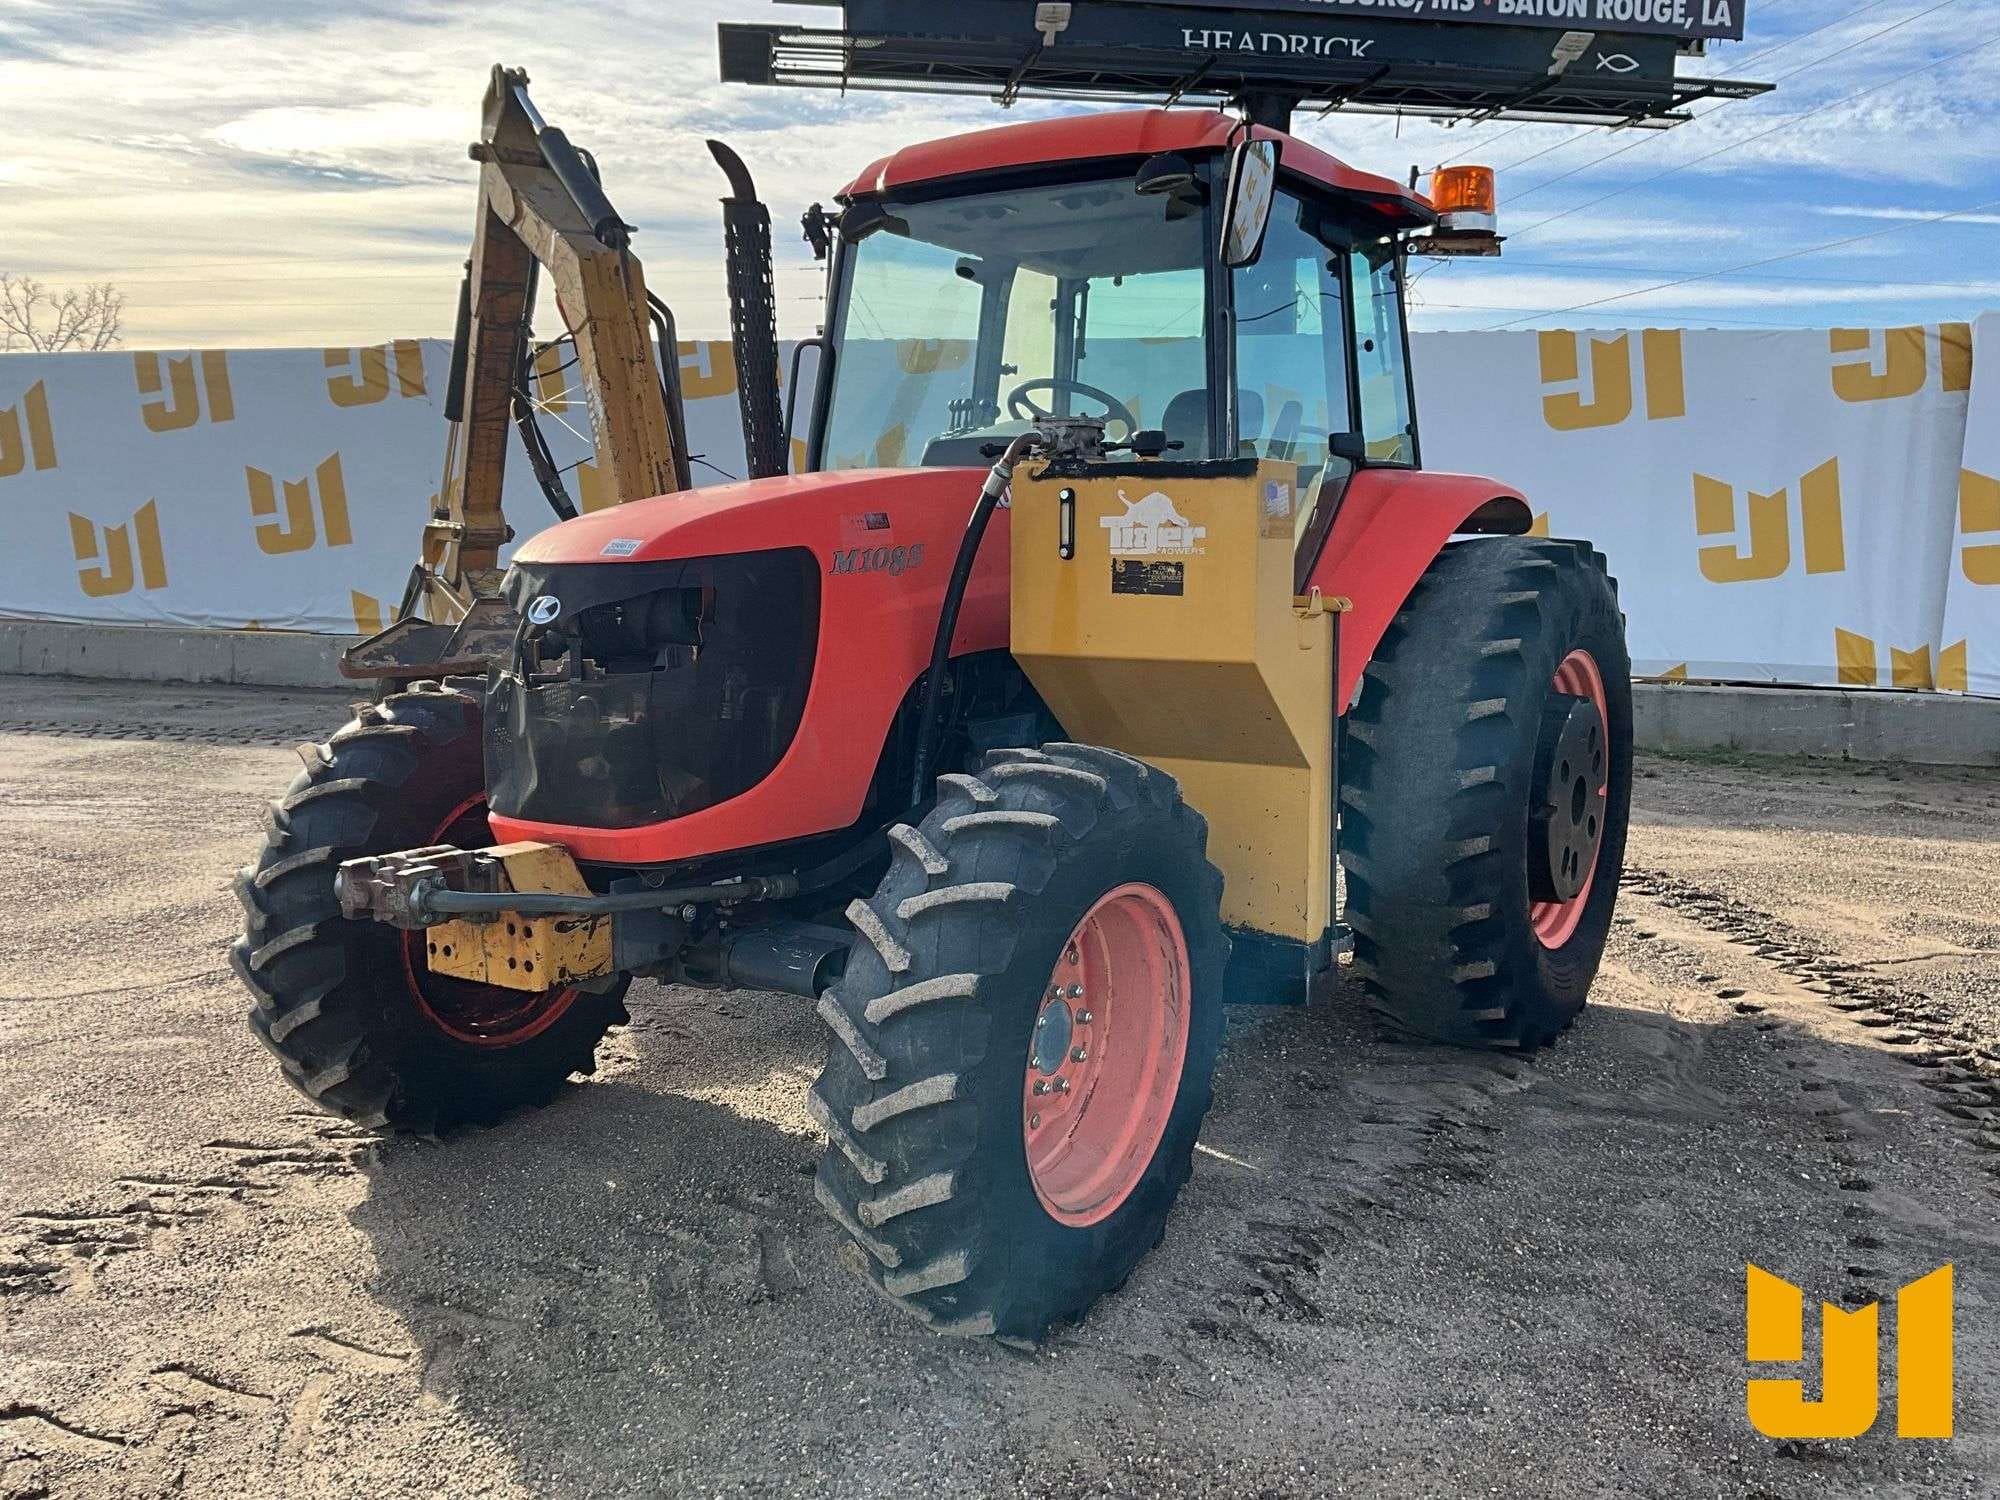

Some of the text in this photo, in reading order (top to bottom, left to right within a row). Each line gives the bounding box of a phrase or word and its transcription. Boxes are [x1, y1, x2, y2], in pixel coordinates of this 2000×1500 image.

[1597, 0, 1694, 29] ROUGE,
[1701, 0, 1732, 27] LA
[1181, 29, 1375, 57] HEADRICK
